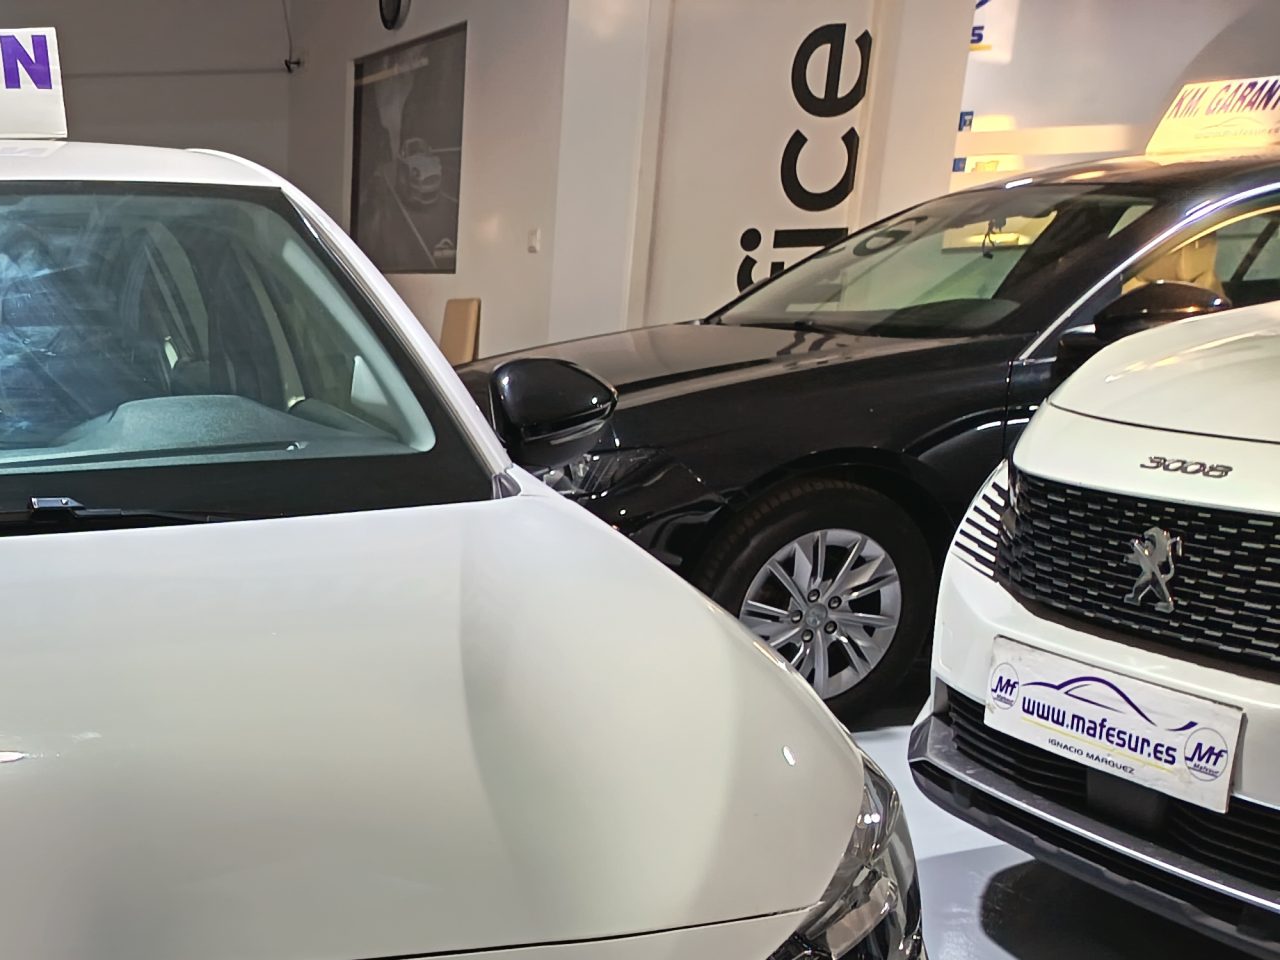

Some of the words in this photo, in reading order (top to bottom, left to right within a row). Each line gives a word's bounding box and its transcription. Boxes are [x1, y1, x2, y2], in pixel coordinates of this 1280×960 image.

[1140, 456, 1233, 479] 3008
[1021, 696, 1177, 765] www.mafesur.es
[1048, 737, 1084, 756] IGNACIO
